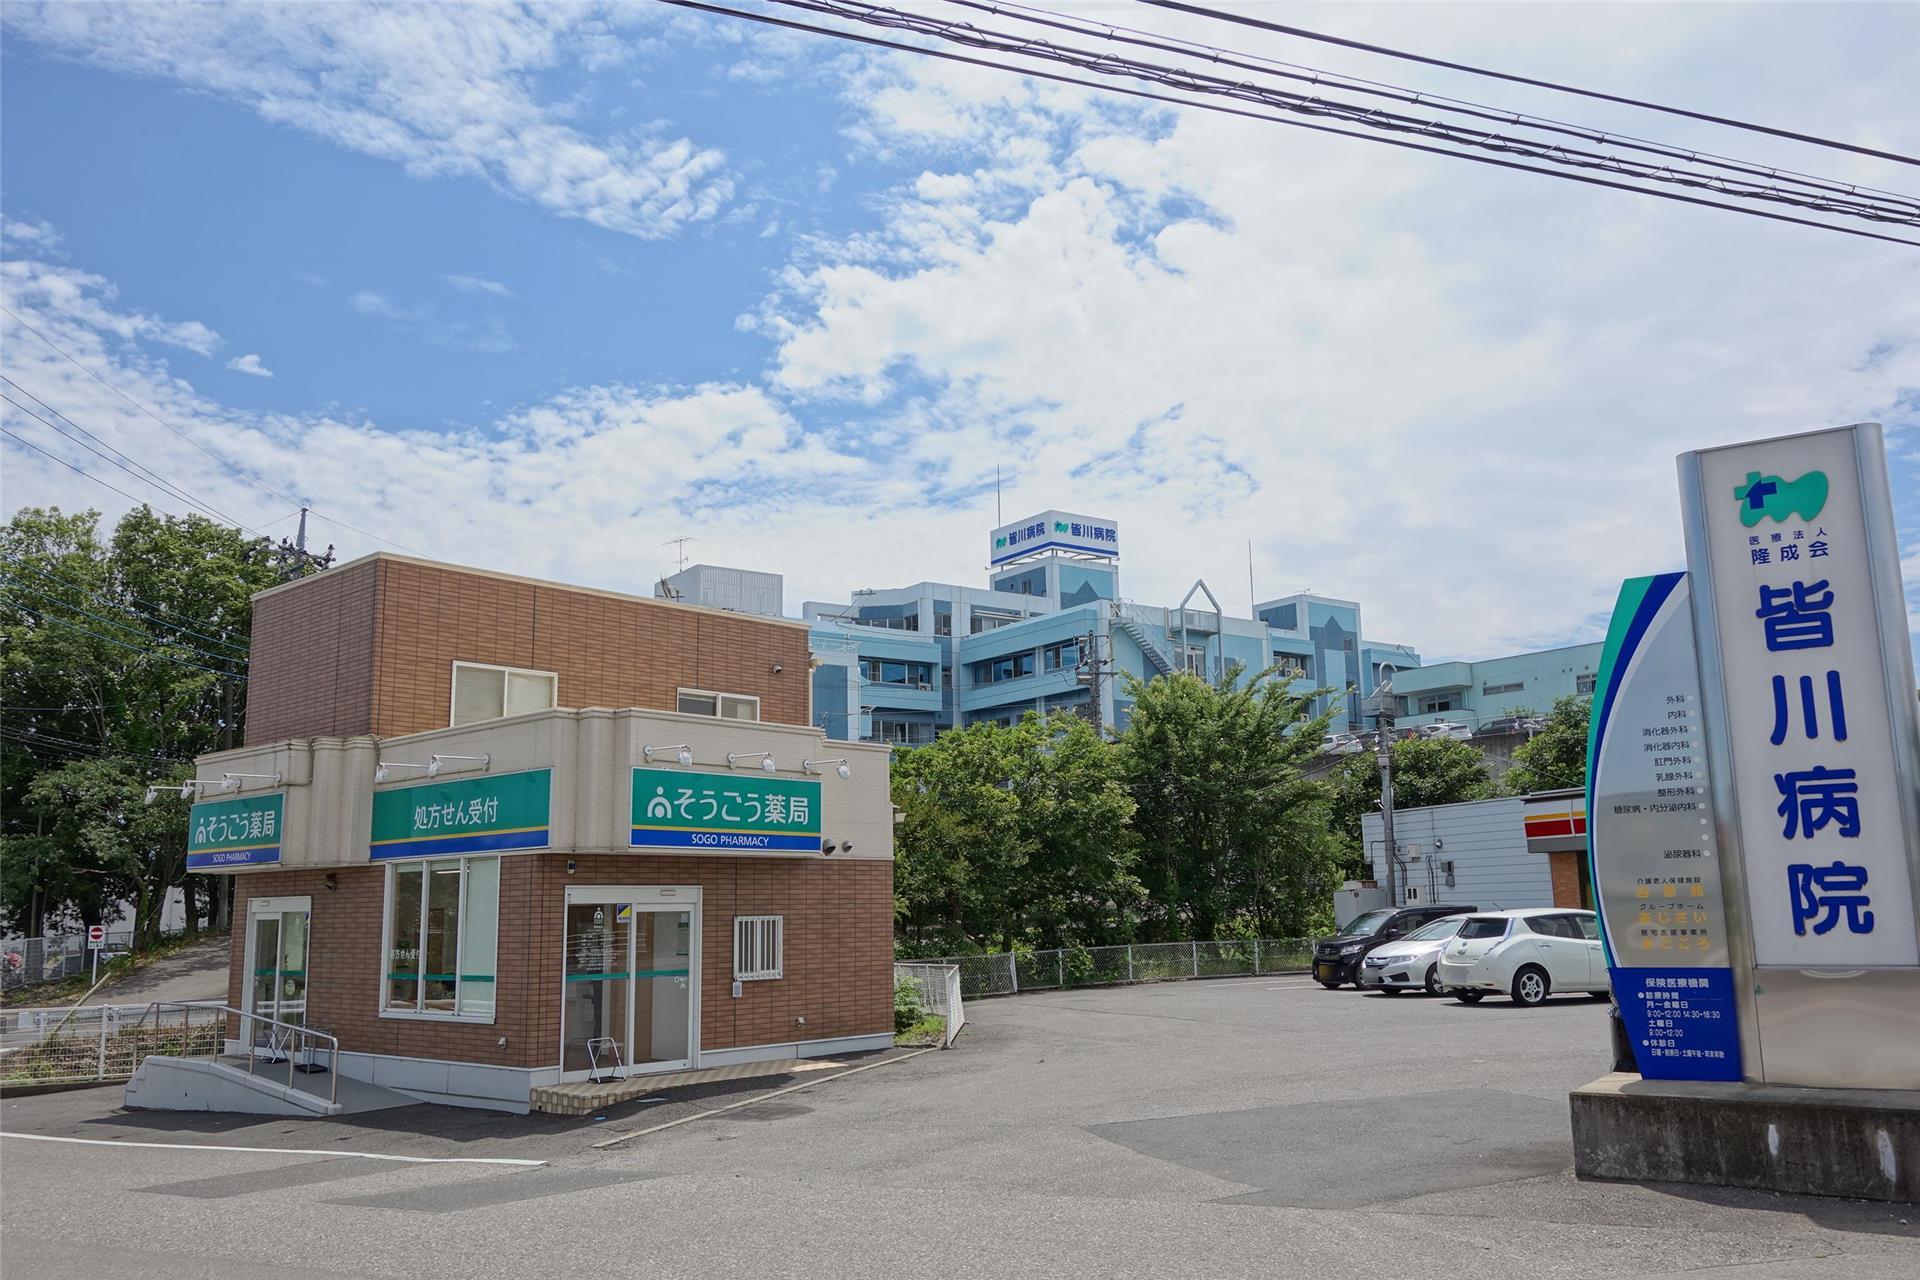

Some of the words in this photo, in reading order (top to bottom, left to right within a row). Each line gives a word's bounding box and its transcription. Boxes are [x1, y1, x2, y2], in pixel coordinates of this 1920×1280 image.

[1009, 522, 1045, 546] 皆川病院
[1071, 522, 1116, 543] 皆川病院
[1749, 527, 1827, 545] 医療法人
[1751, 540, 1829, 565] 隆成会
[1666, 694, 1685, 704] 外科
[1667, 710, 1687, 719] 内科
[1642, 725, 1688, 736] 消化器外科
[1643, 741, 1689, 752] 消化器内科
[1654, 756, 1691, 766] 肛門外科
[1756, 579, 1874, 936] 皆川病院
[1657, 787, 1695, 797] 整形外科
[674, 788, 808, 825] そうごう薬局
[414, 796, 498, 830] 処方せん受付
[207, 811, 275, 842] そうごう薬局
[692, 834, 718, 845] SOGO
[720, 835, 770, 846] PHARMACY
[212, 854, 226, 863] SOGO
[226, 851, 252, 862] PHARMACY
[1664, 849, 1701, 859] 泌尿器科
[1645, 978, 1709, 988] 保険医療機関
[1645, 991, 1680, 1000] 診療時間
[1648, 1019, 1674, 1027] 土曜日
[1650, 1039, 1676, 1048] 休診日
